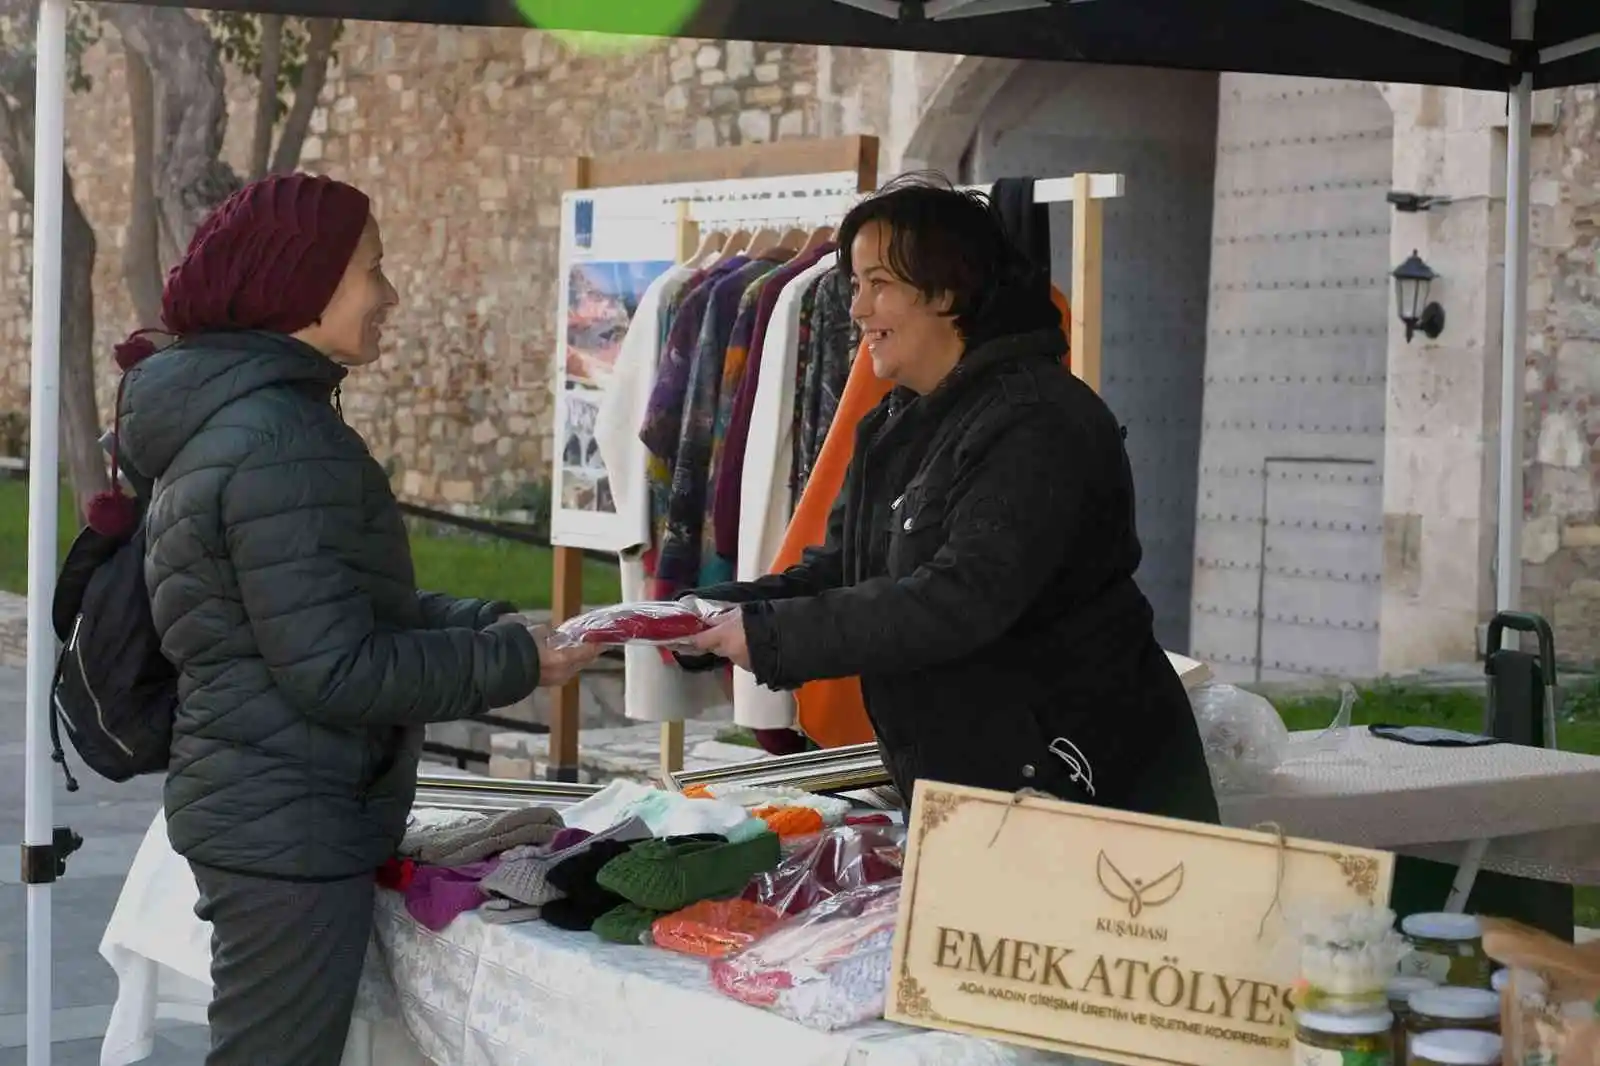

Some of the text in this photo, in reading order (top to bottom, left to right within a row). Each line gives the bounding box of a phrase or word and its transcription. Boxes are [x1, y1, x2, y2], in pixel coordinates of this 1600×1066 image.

[1096, 917, 1168, 942] KUŞADASI
[933, 926, 1075, 989] EMEK
[988, 987, 1027, 1004] KADIN
[1131, 1011, 1147, 1025] VE
